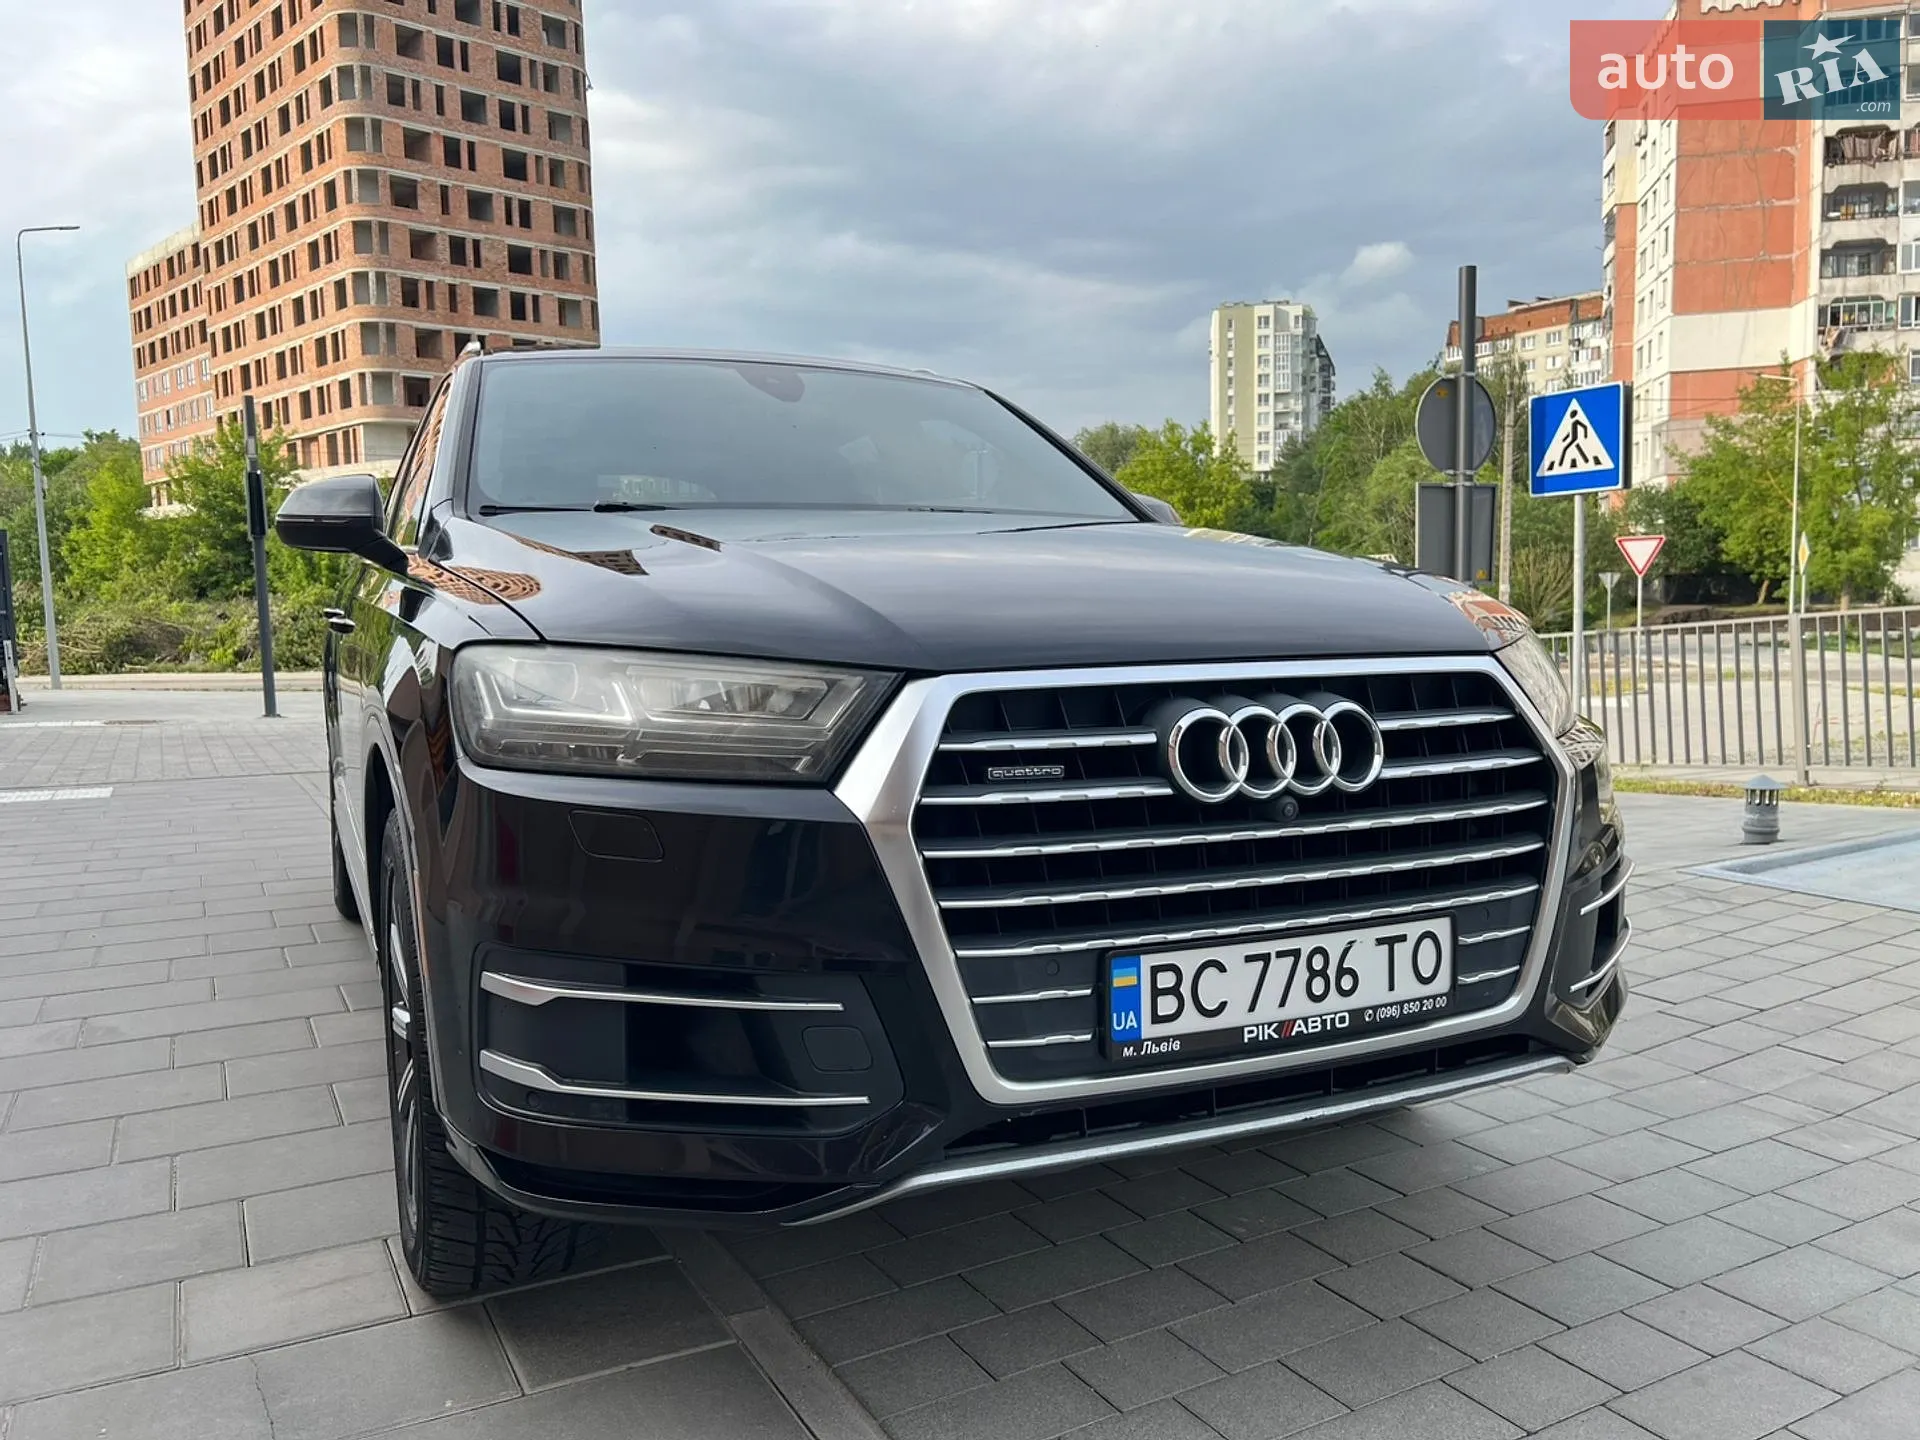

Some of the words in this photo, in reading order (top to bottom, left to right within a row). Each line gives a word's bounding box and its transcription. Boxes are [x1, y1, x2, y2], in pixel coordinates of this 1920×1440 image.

[992, 767, 1061, 778] quattro
[1150, 959, 1228, 1025] BC
[1244, 939, 1359, 1013] 7786
[1375, 930, 1442, 992] TO
[1376, 1004, 1401, 1023] (096)
[1403, 1001, 1421, 1015] 850
[1421, 999, 1434, 1012] 20
[1435, 996, 1447, 1009] 00
[1113, 1010, 1138, 1031] UA
[1122, 1044, 1139, 1057] м.
[1141, 1039, 1181, 1056] Львів
